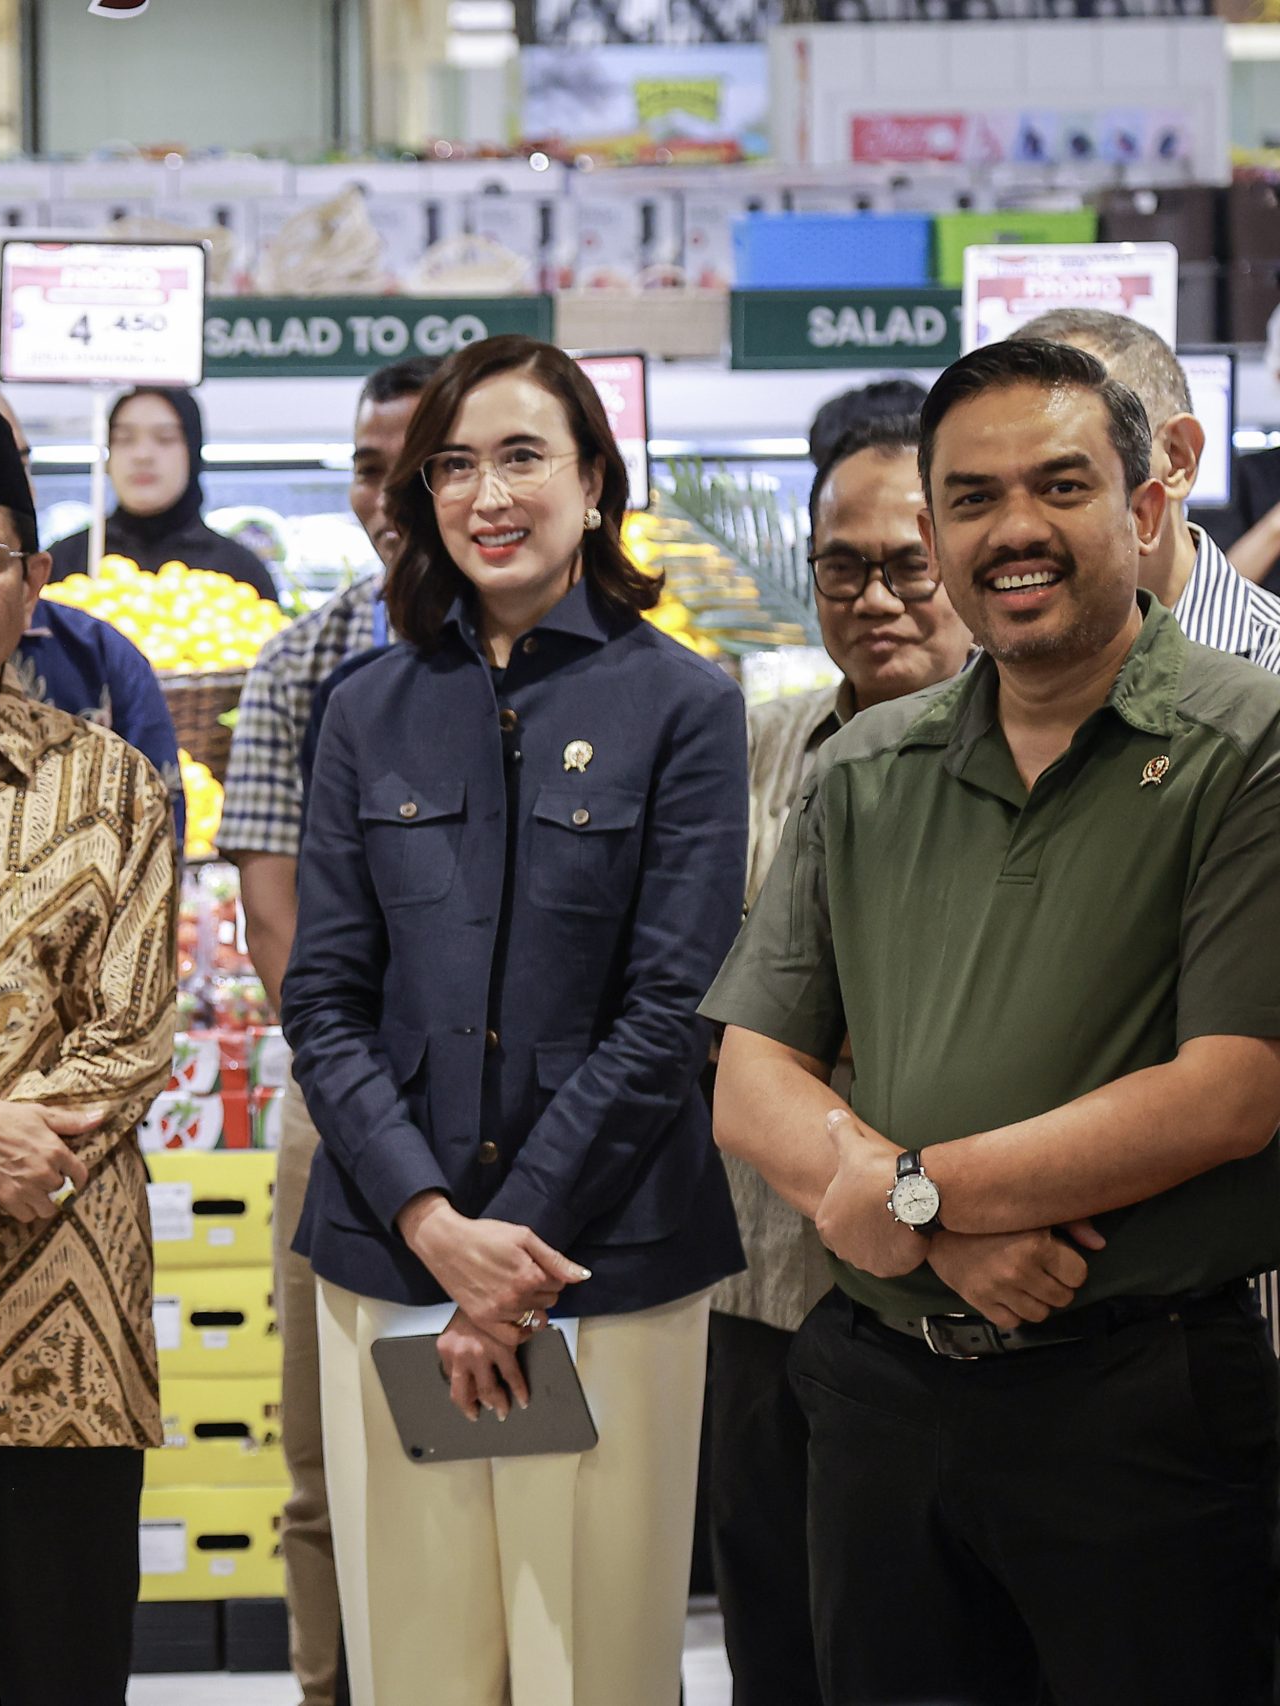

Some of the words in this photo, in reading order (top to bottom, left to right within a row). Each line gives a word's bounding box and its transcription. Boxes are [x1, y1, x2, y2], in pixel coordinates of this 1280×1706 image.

[204, 316, 343, 358] SALAD
[347, 315, 410, 356] TO
[414, 315, 489, 356] GO
[808, 305, 947, 347] SALAD
